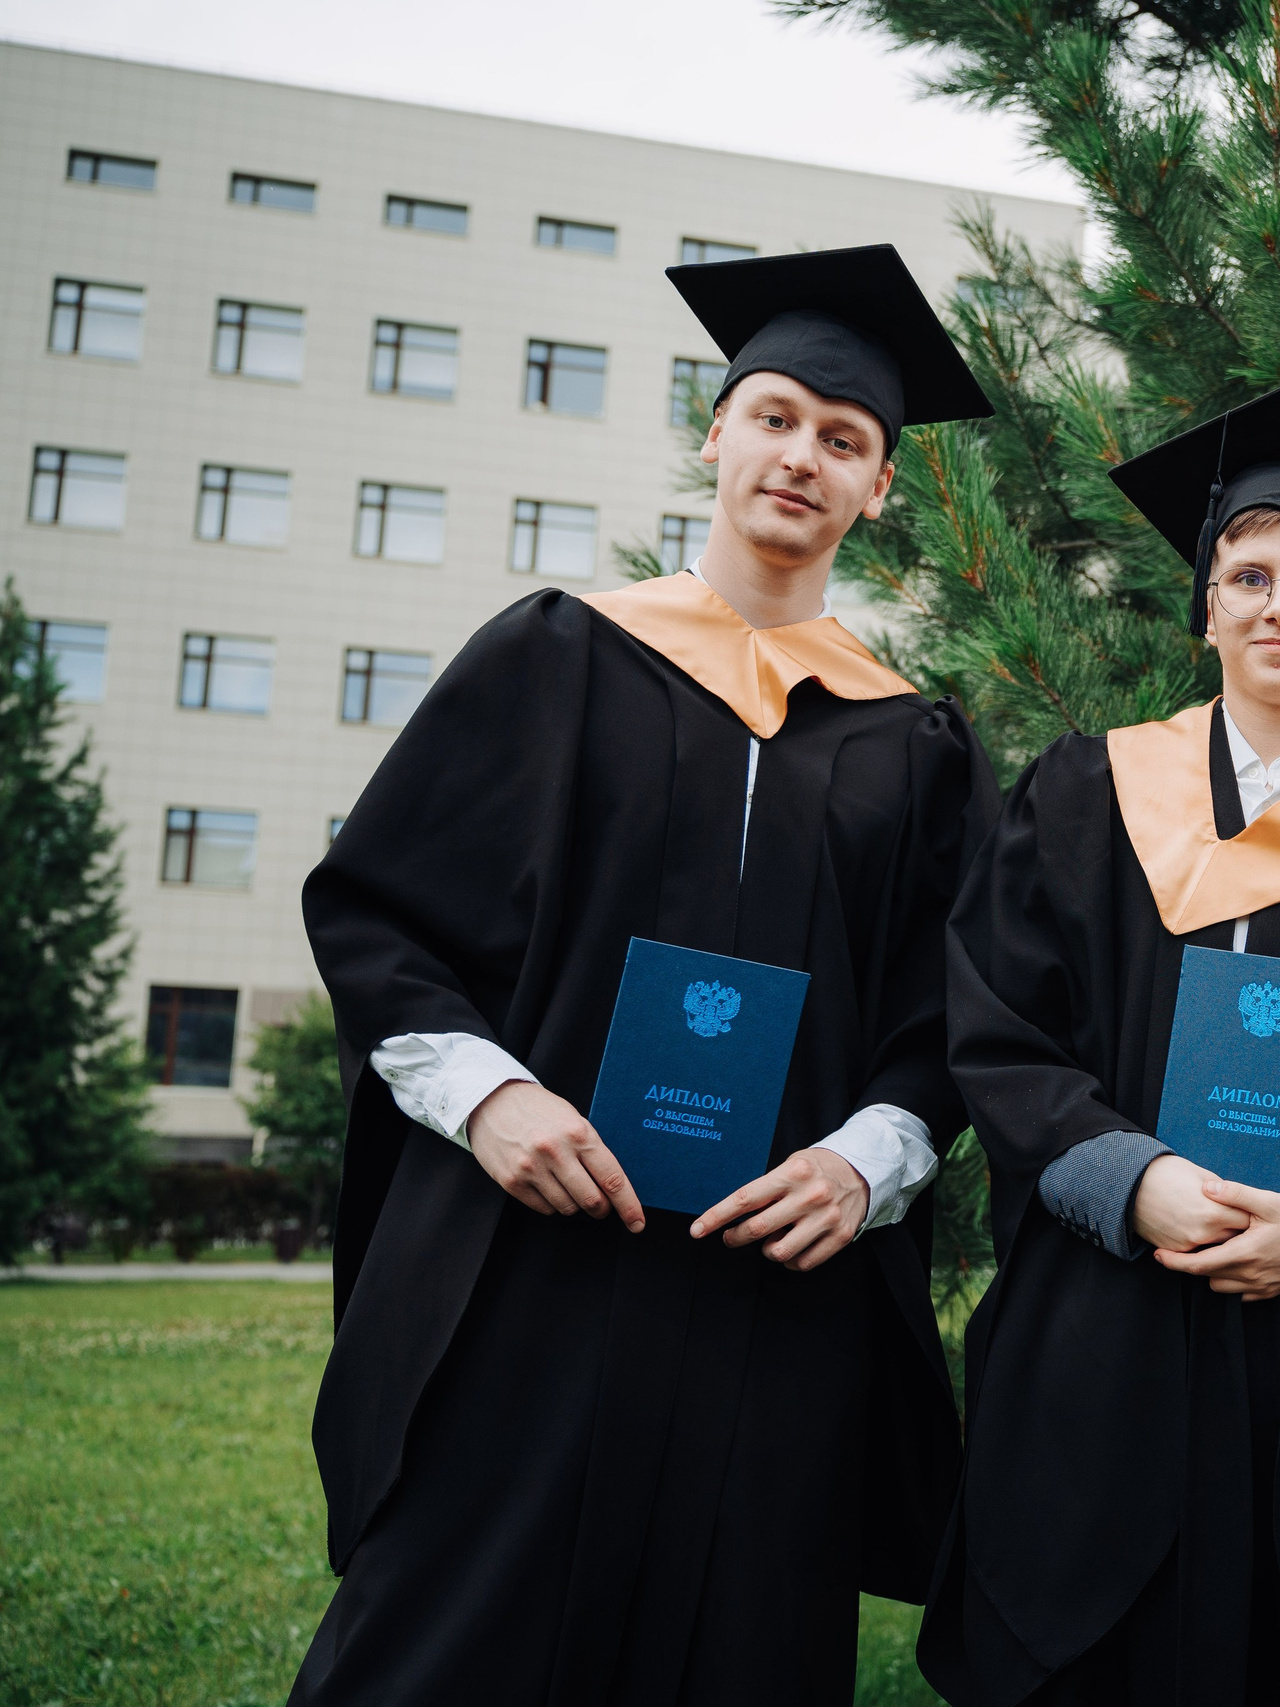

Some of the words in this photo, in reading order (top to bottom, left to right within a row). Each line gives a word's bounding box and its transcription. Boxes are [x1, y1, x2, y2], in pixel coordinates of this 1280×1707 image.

[645, 1084, 731, 1112] ДИПЛОМ
[655, 1108, 664, 1118] О
[665, 1110, 714, 1126] ВЫСШЕМ
[1218, 1109, 1227, 1118] О
[1228, 1111, 1276, 1125] ВЫСШЕМ
[643, 1118, 722, 1141] ОБРАЗОВАНИИ
